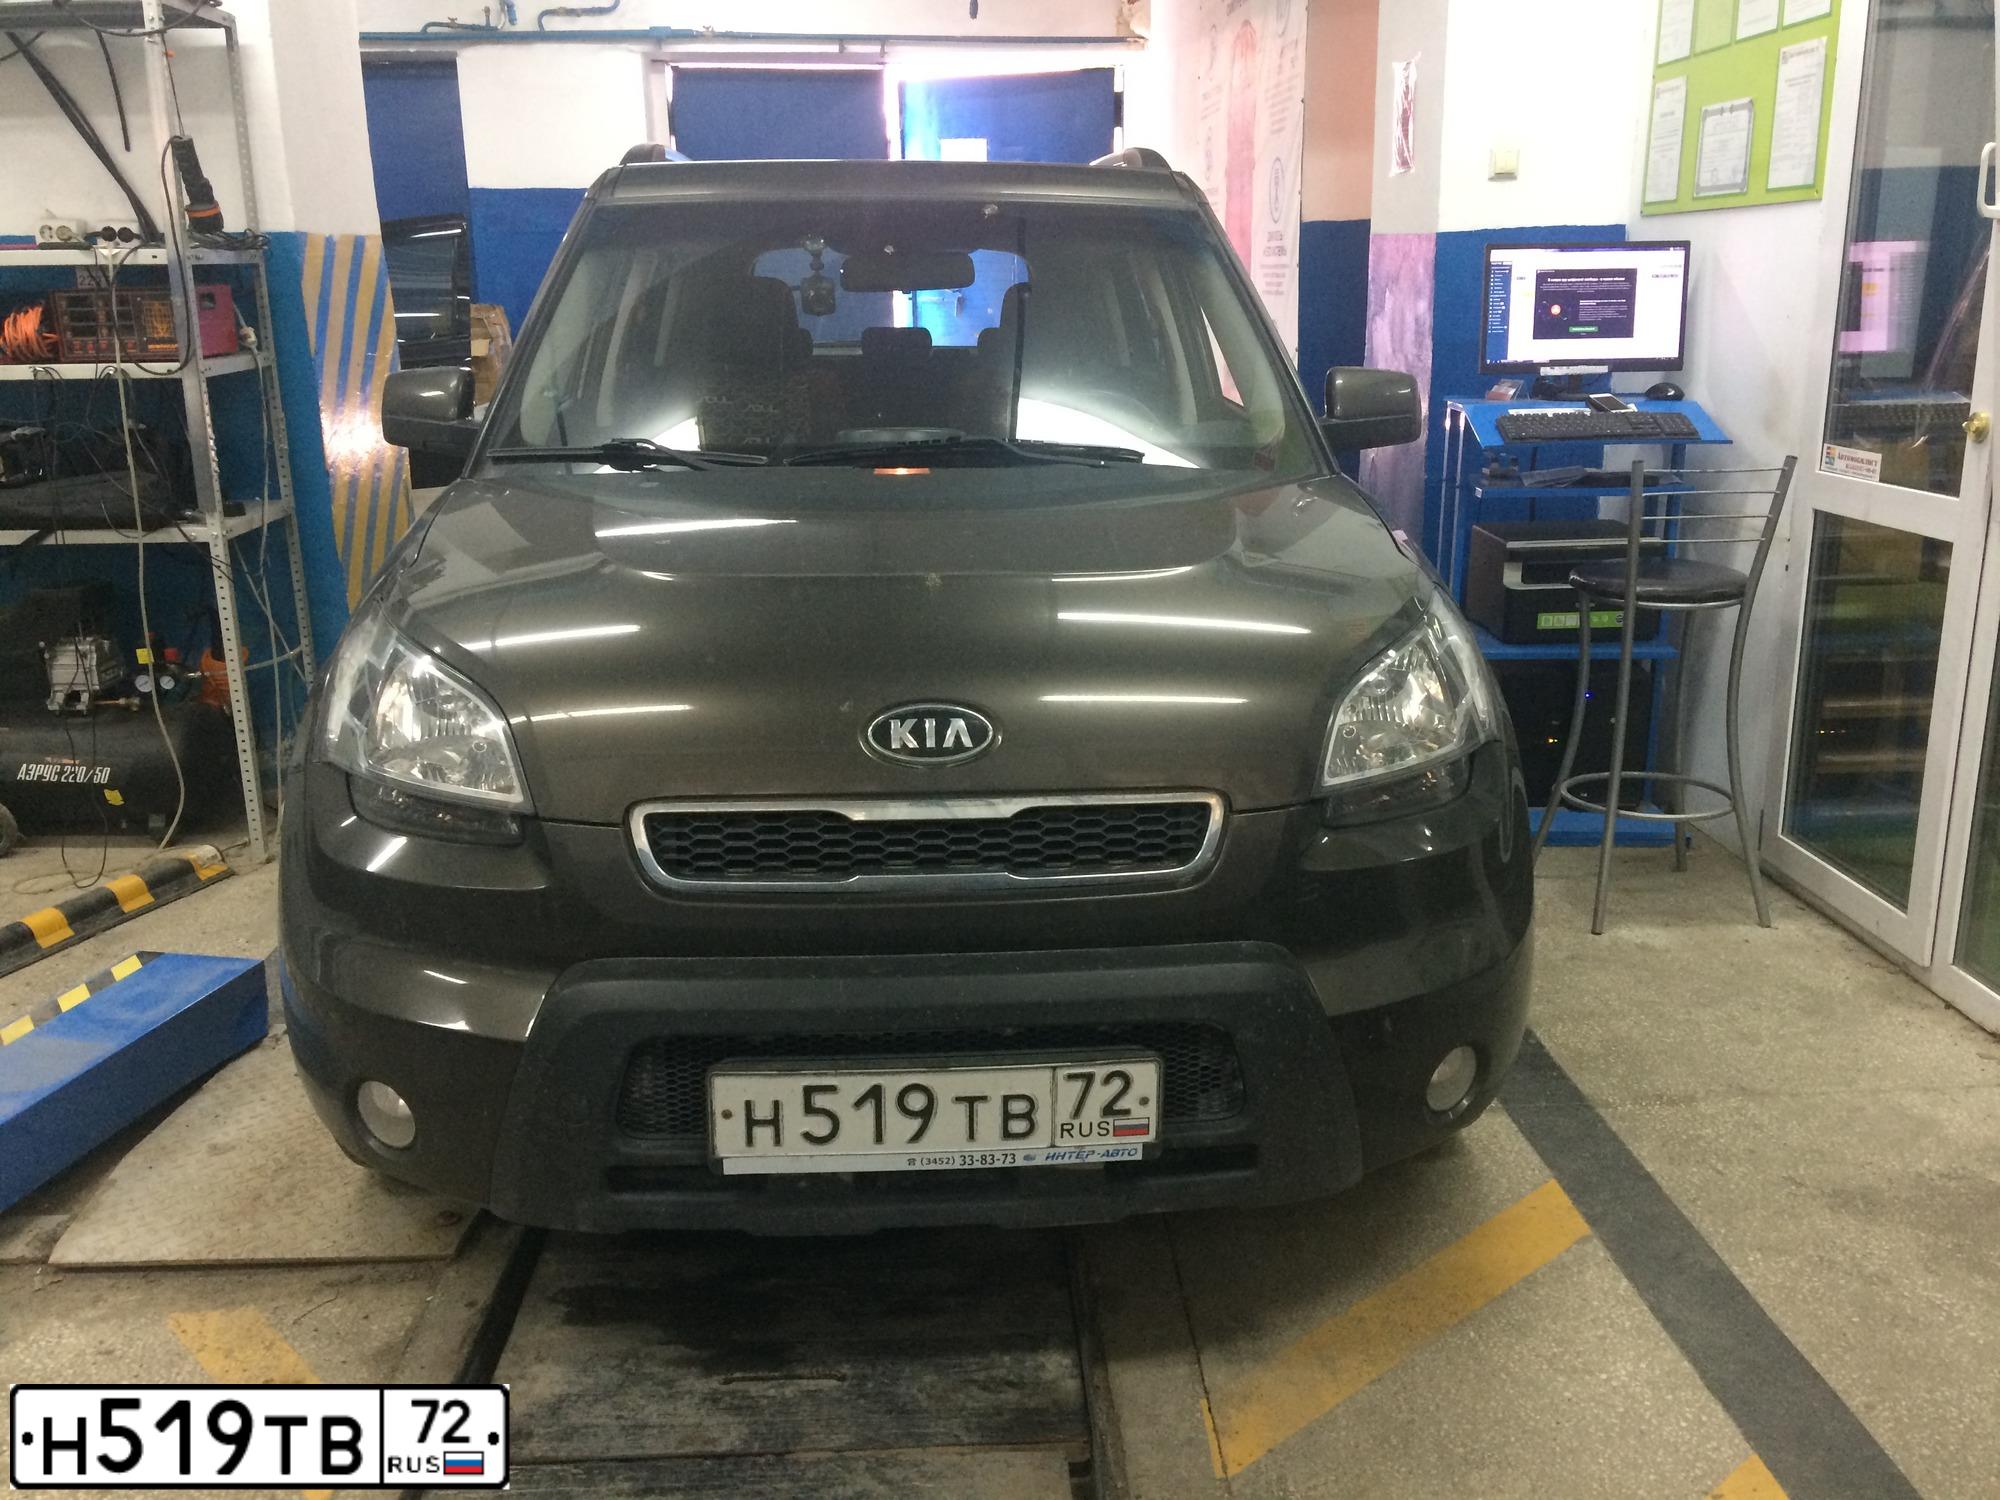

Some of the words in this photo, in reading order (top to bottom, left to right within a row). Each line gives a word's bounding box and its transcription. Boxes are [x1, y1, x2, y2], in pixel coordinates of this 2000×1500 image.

[889, 718, 973, 749] KIA
[16, 763, 61, 782] АЭРУС
[61, 765, 111, 784] 220/50
[1063, 1070, 1133, 1120] 72
[1060, 1120, 1110, 1139] RUS
[920, 1156, 955, 1167] (3452)
[959, 1153, 1017, 1167] 33-83-73
[1045, 1148, 1137, 1162] ИНТЕР-АВТО
